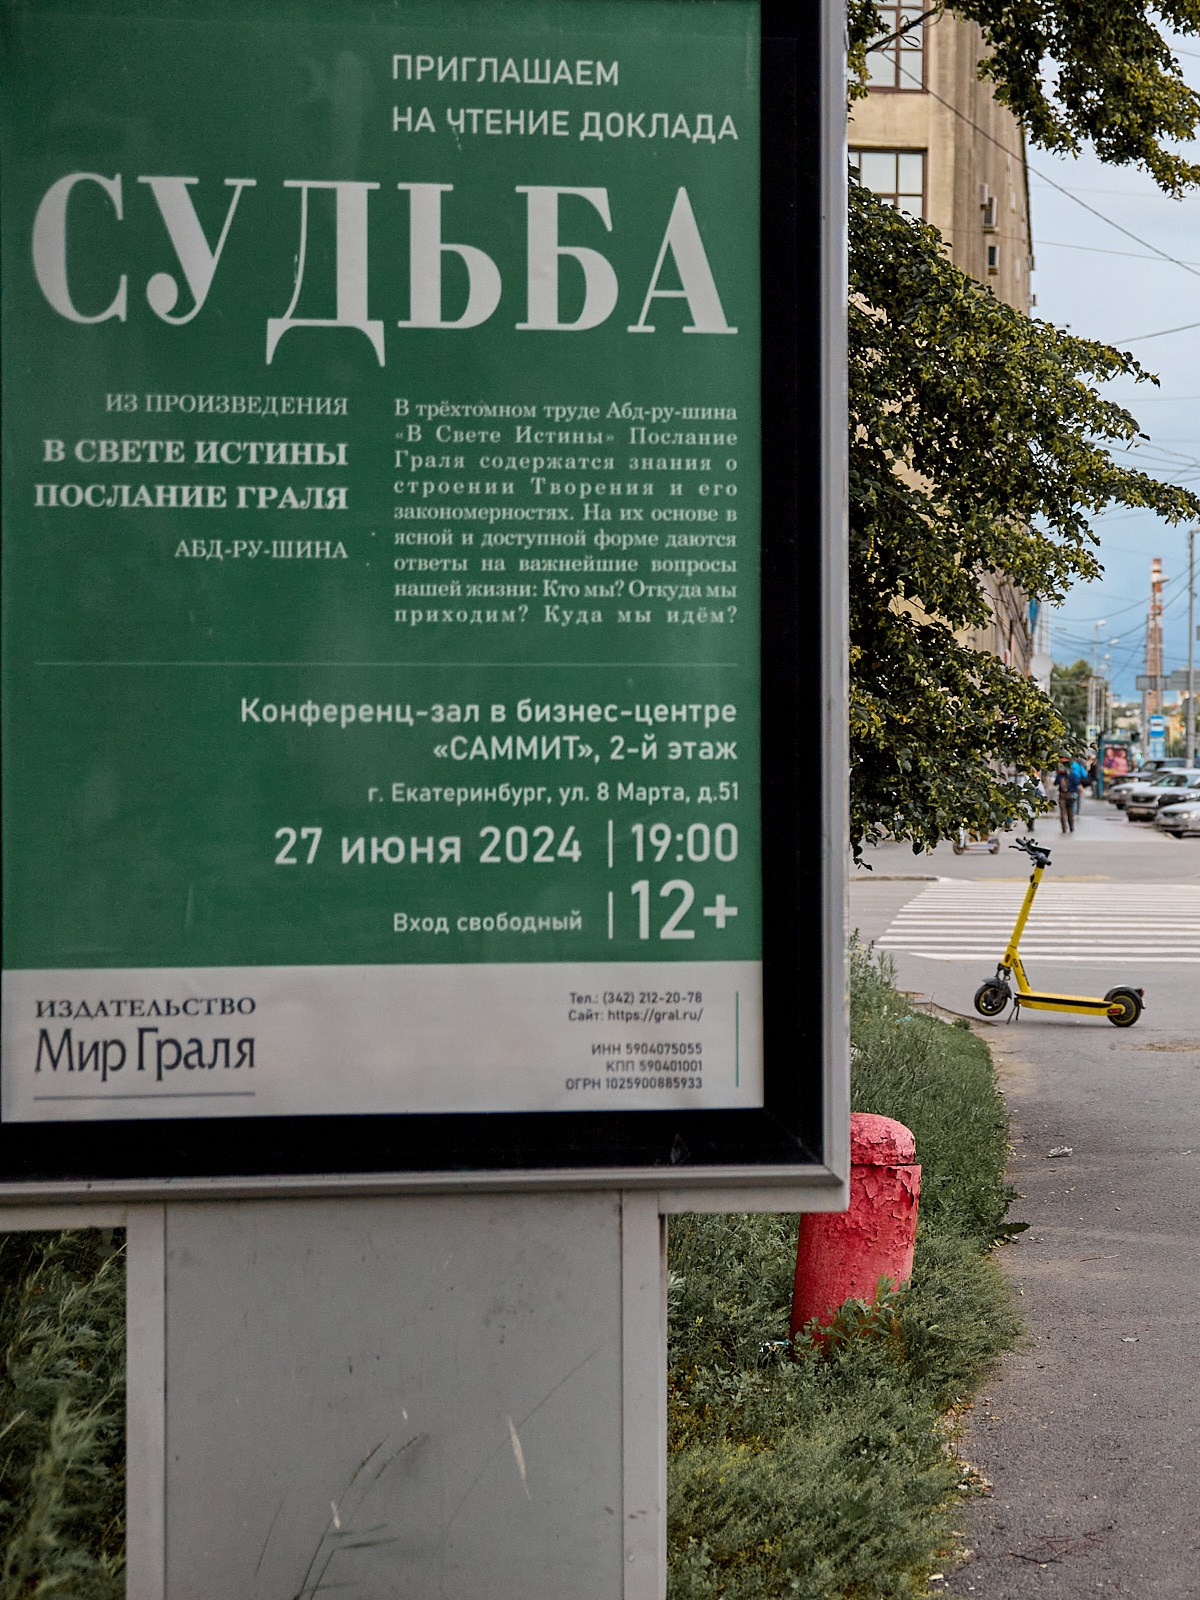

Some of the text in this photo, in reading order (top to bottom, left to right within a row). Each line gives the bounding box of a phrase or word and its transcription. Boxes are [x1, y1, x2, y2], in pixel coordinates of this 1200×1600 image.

[393, 55, 618, 86] ПРИГЛАШАЕМ
[393, 107, 738, 144] НА ЧТЕНИЕ ДОКЛАДА
[33, 173, 738, 367] СУДЬБА
[107, 394, 347, 416] ИЗ ПРОИЗВЕДЕНИЯ
[395, 399, 737, 423] В трёхтомном труде Абд-ру-шина
[396, 425, 737, 445] «В Свете Истины» Послание
[43, 439, 348, 465] В СВЕТЕ ИСТИНЫ
[395, 450, 737, 473] Граля содержатся знания о
[35, 485, 348, 509] ПОСЛАНИЕ ГРАЛЯ
[394, 477, 737, 499] строении Творения и его
[394, 503, 737, 524] закономерностях. На их основе в
[175, 540, 348, 560] АБД-РУ-ШИНА
[395, 529, 736, 550] ясной и доступной форме даются
[394, 555, 736, 576] ответы на важнейшие вопросы
[395, 580, 736, 601] нашей жизни: Кто мы? Откуда мы
[395, 605, 737, 626] приходим? Куда мы идём?
[242, 698, 736, 728] Конференц-зал в бизнес-центре
[434, 734, 737, 763] «САММИТ», 2-й этаж
[368, 782, 738, 806] г. Екатеринбург, ул. 8 Марта, д.51
[275, 823, 738, 864] 27 июня 2024 19:00
[631, 879, 738, 939] 12+
[394, 910, 582, 934] Вход свободный
[36, 998, 255, 1019] ИЗДАТЕЛЬСТВО
[603, 992, 634, 1005] (342)
[569, 1008, 703, 1023] Сайт: https://gral.ru/
[35, 1027, 254, 1082] Мир Граля
[592, 1043, 702, 1055] ИНН 5904075055
[606, 1060, 702, 1072] КПП 590401001
[566, 1078, 600, 1090] ОГРН
